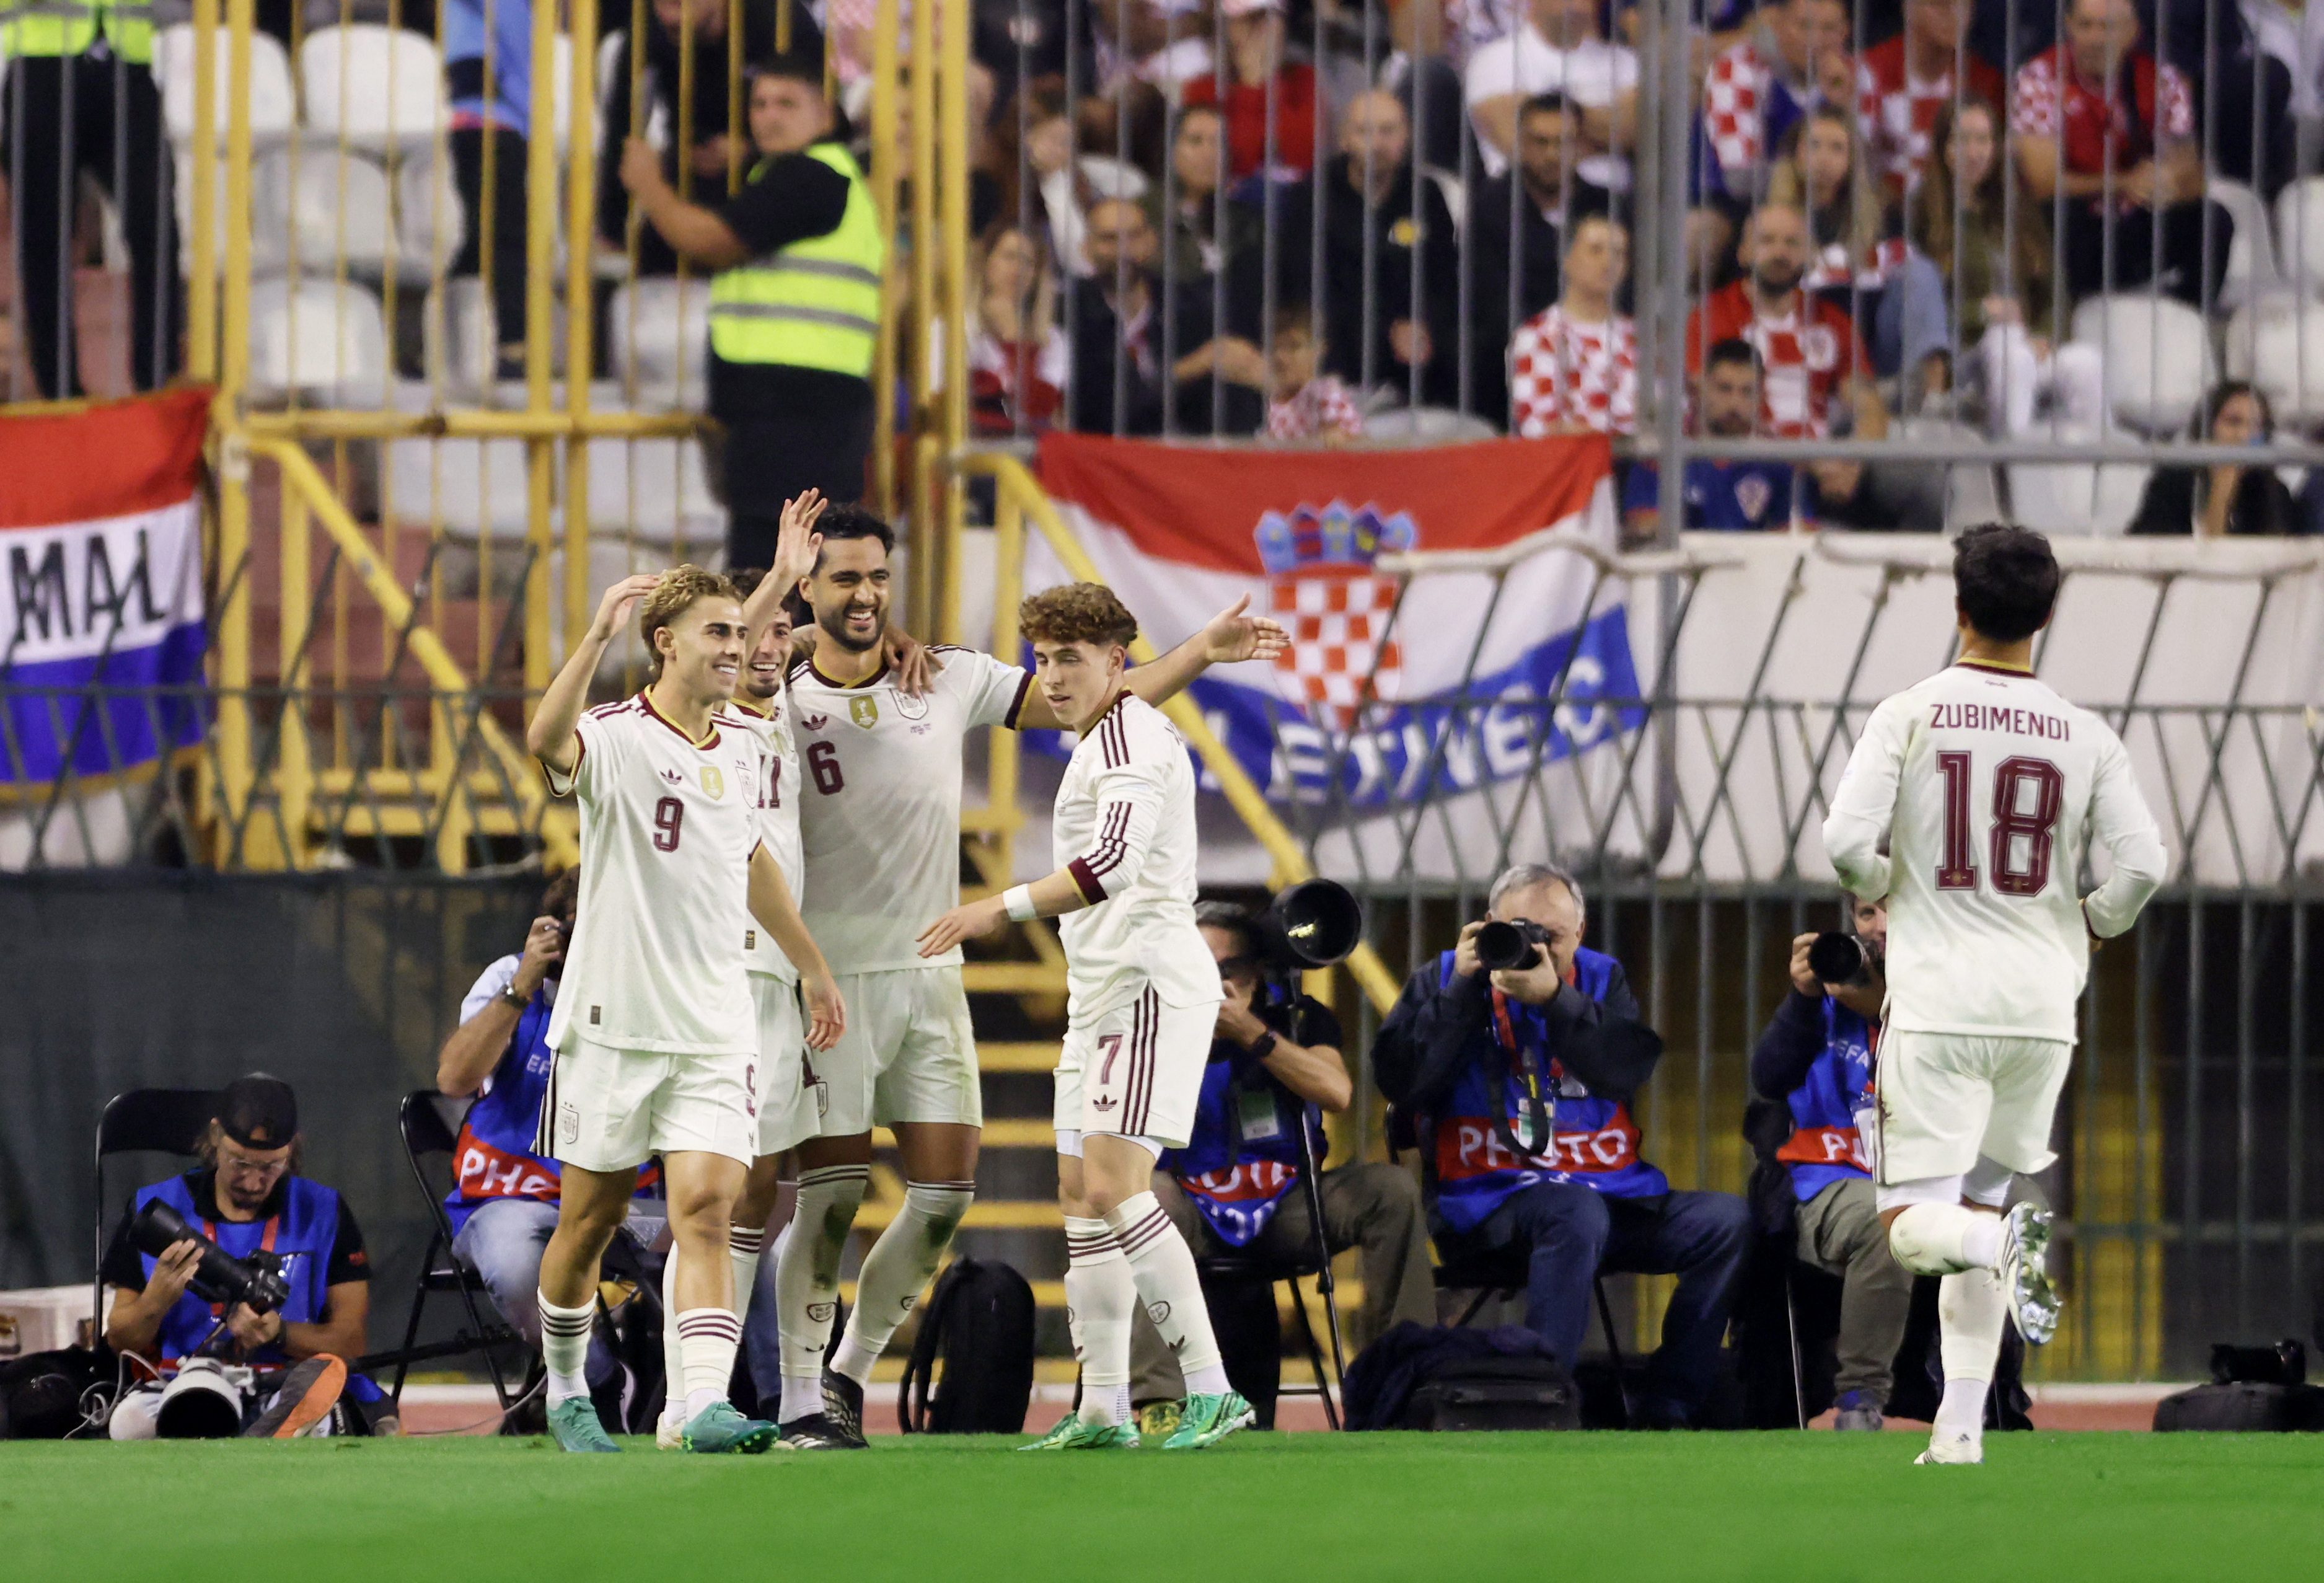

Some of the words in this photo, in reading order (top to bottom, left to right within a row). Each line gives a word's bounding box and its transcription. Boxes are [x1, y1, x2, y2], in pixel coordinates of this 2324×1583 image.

[1930, 703, 2069, 742] ZUBIMENDI
[807, 741, 845, 796] 6
[654, 796, 684, 853] 9
[1935, 751, 2064, 897] 18
[1098, 1034, 1124, 1085] 7
